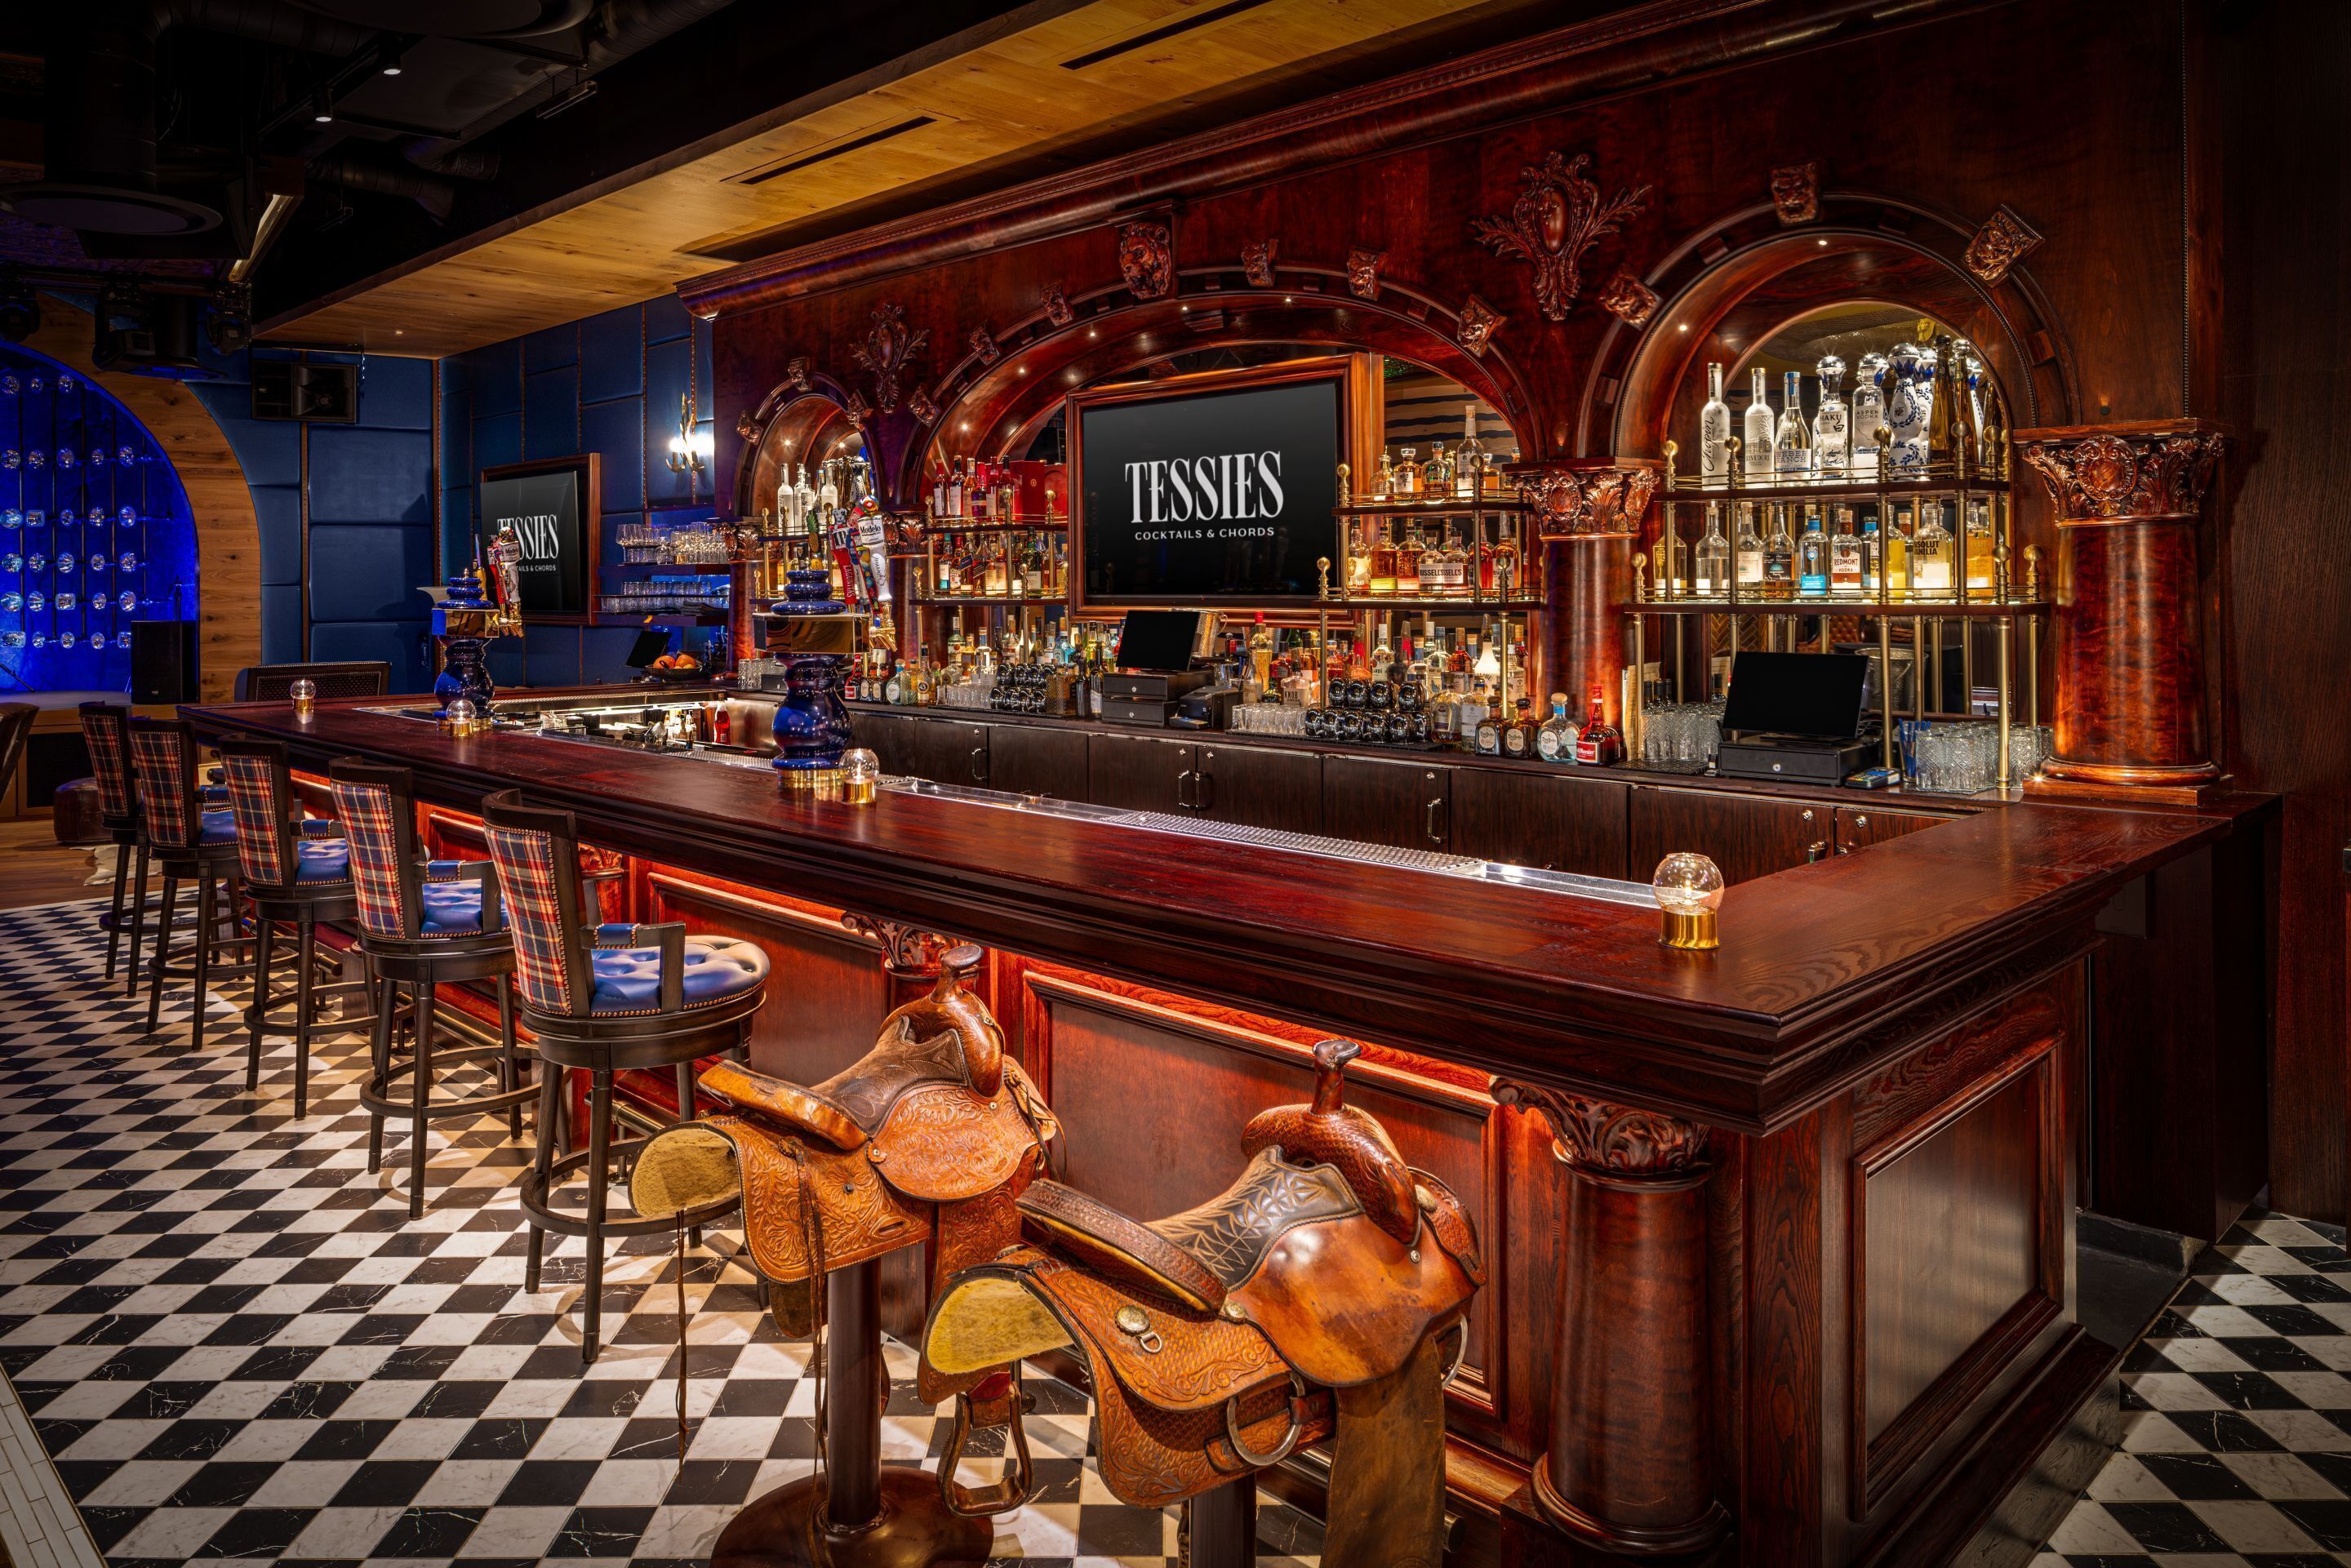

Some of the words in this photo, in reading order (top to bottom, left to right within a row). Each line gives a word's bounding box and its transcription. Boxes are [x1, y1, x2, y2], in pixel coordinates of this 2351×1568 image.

[1702, 416, 1720, 472] Chopin
[1125, 451, 1284, 523] TESSIES
[860, 525, 882, 534] Modelo
[1135, 529, 1202, 541] COCKTAILS
[1207, 529, 1215, 538] &
[1219, 526, 1275, 538] CHORDS
[1913, 540, 1940, 549] BSOLUT
[1833, 558, 1858, 566] REDMONT
[1284, 691, 1298, 699] KNOB
